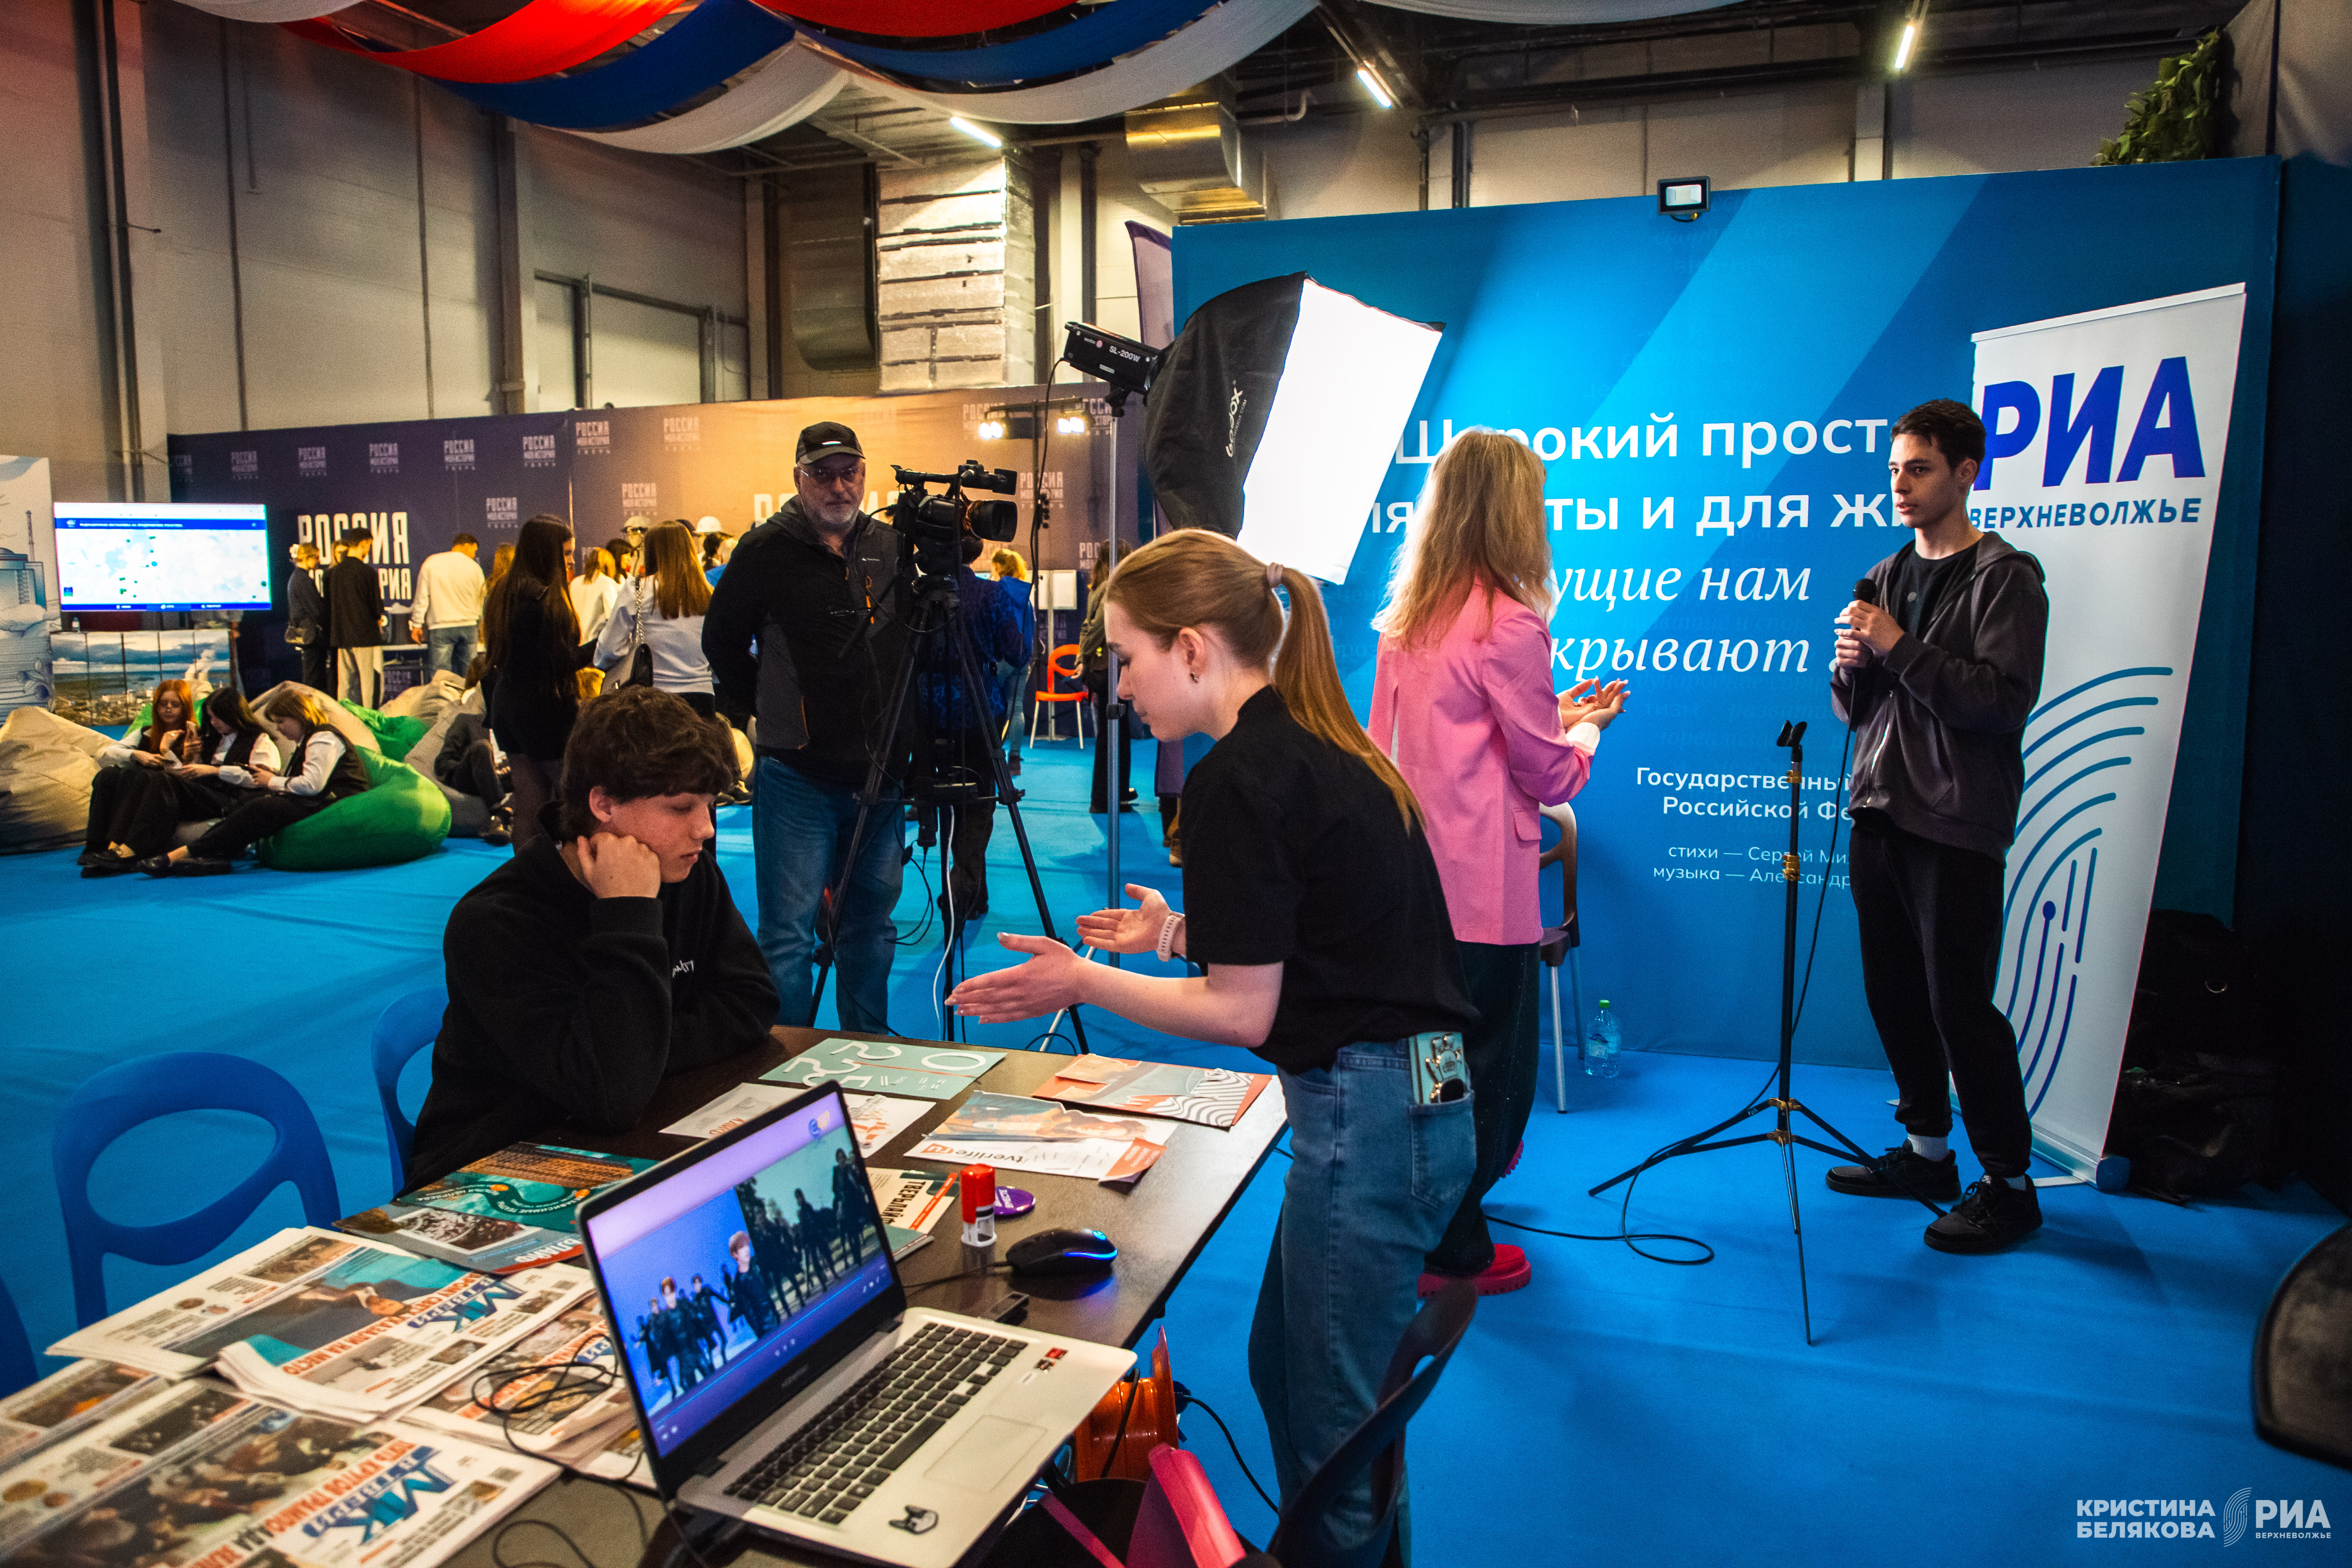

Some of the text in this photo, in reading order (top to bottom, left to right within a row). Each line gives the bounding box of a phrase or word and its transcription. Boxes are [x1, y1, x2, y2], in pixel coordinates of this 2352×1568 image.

[1109, 346, 1141, 362] SL-200W
[1395, 412, 1888, 469] Шокий прост
[1973, 356, 2206, 491] РИА
[1643, 496, 1674, 530] и
[1696, 494, 1810, 537] для
[1970, 498, 2202, 529] ВЕРХНЕВОЛЖЬЕ
[1550, 566, 1811, 612] ущие нам
[1552, 637, 1809, 683] крывают
[1637, 767, 1850, 792] Государствены
[1654, 866, 1720, 881] музыка
[1668, 846, 1718, 858] стихи
[332, 1462, 457, 1546] МК
